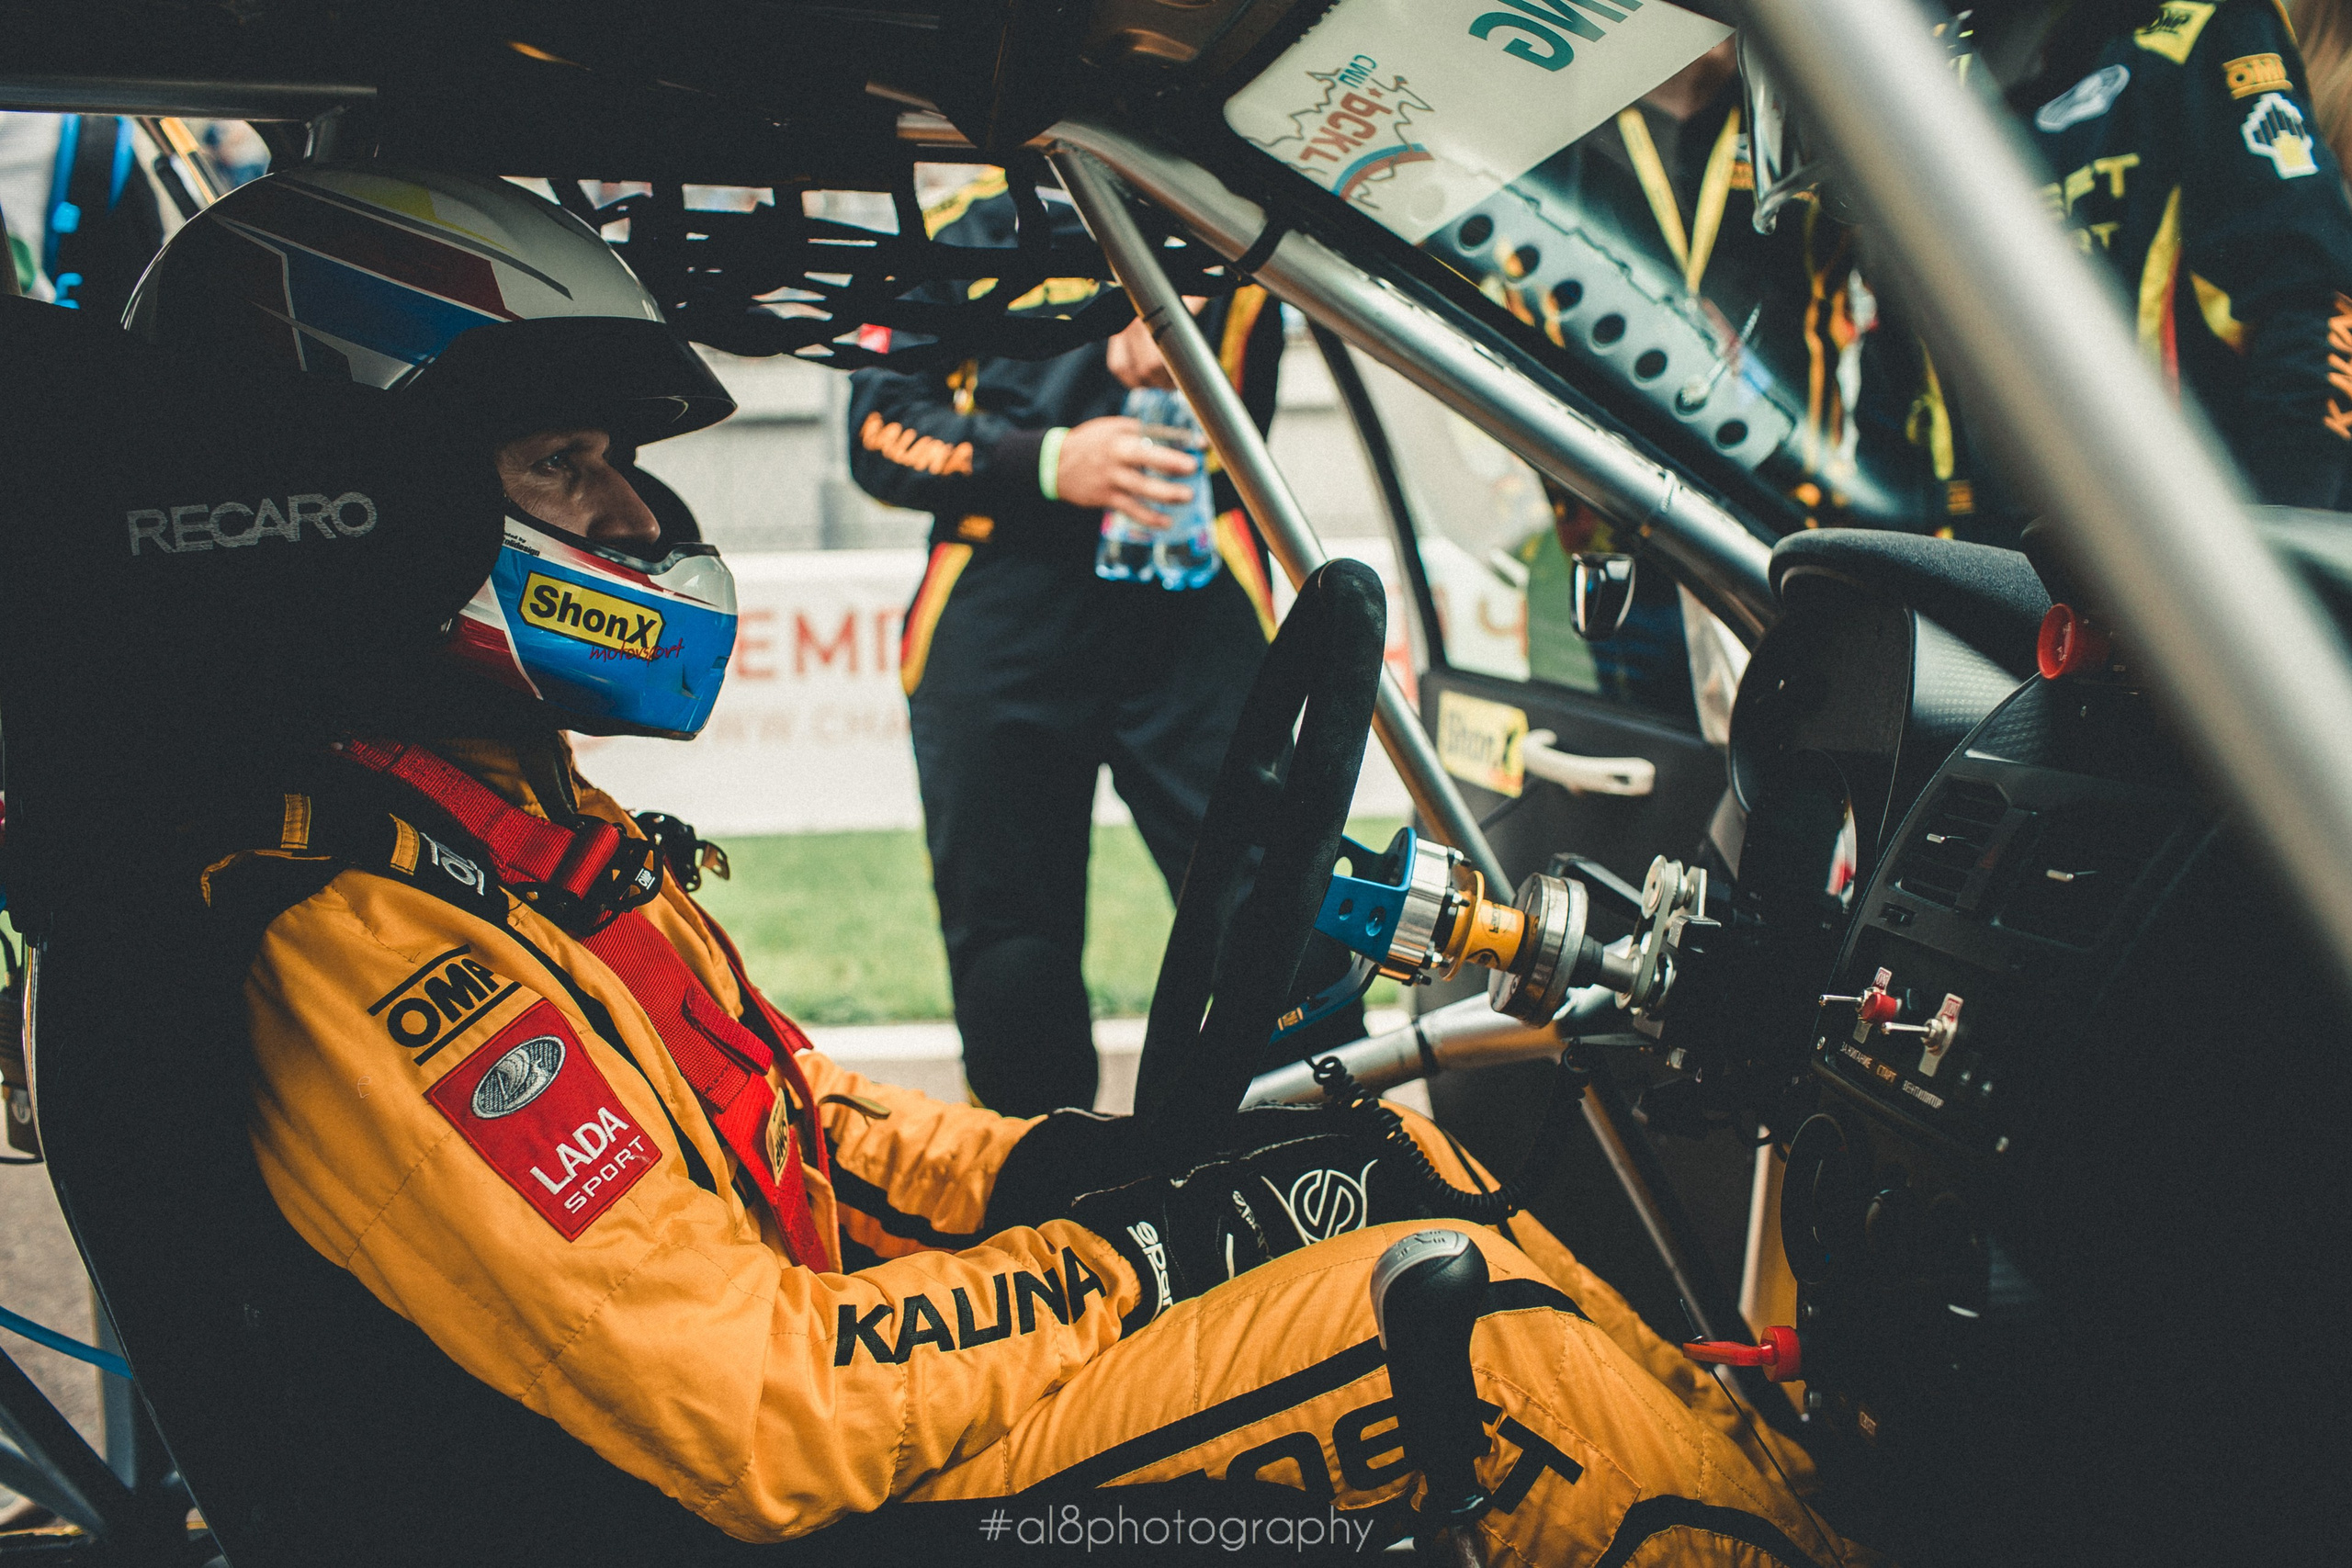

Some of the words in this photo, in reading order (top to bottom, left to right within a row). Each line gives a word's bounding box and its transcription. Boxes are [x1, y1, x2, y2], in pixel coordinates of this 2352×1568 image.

[127, 491, 378, 556] RECARO
[504, 539, 540, 557] olidesign
[530, 584, 658, 649] ShonX
[589, 637, 684, 667] motorsport
[387, 958, 501, 1048] OMP
[530, 1107, 630, 1195] LADA
[563, 1135, 645, 1213] SPORT
